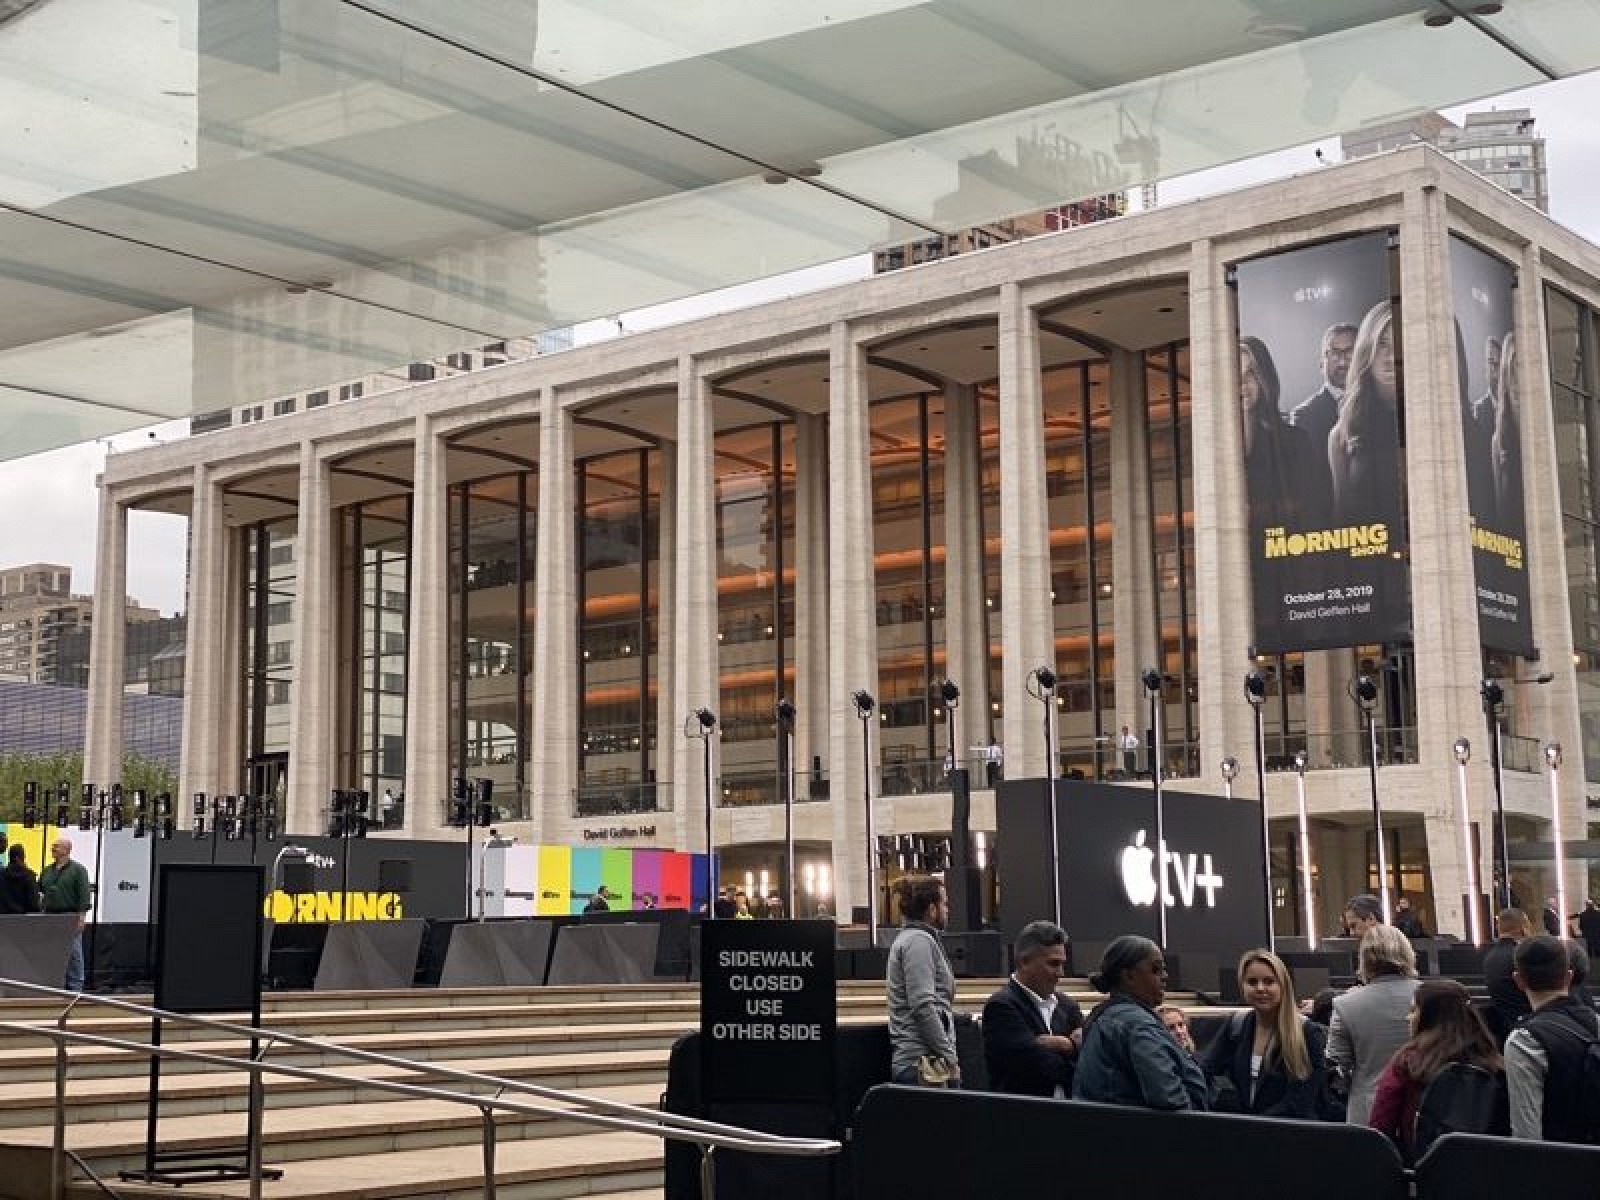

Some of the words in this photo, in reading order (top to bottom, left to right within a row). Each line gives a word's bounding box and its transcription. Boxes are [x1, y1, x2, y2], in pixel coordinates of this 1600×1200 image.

[1265, 528, 1284, 537] THE
[1265, 524, 1388, 558] MORNING
[1350, 545, 1388, 556] SHOW
[1284, 592, 1324, 604] October
[1327, 588, 1344, 600] 28,
[1345, 586, 1373, 598] 2019
[1289, 609, 1317, 620] David
[1318, 606, 1350, 617] Geffen
[1351, 602, 1370, 614] Hall
[584, 828, 608, 840] David
[639, 825, 656, 837] Hall
[1160, 839, 1224, 908] tv+
[264, 889, 402, 923] ORNING
[719, 951, 814, 967] SIDEWALK
[729, 975, 804, 991] CLOSED
[745, 999, 783, 1016] USE
[713, 1023, 775, 1040] OTHER
[779, 1023, 821, 1040] SIDE
